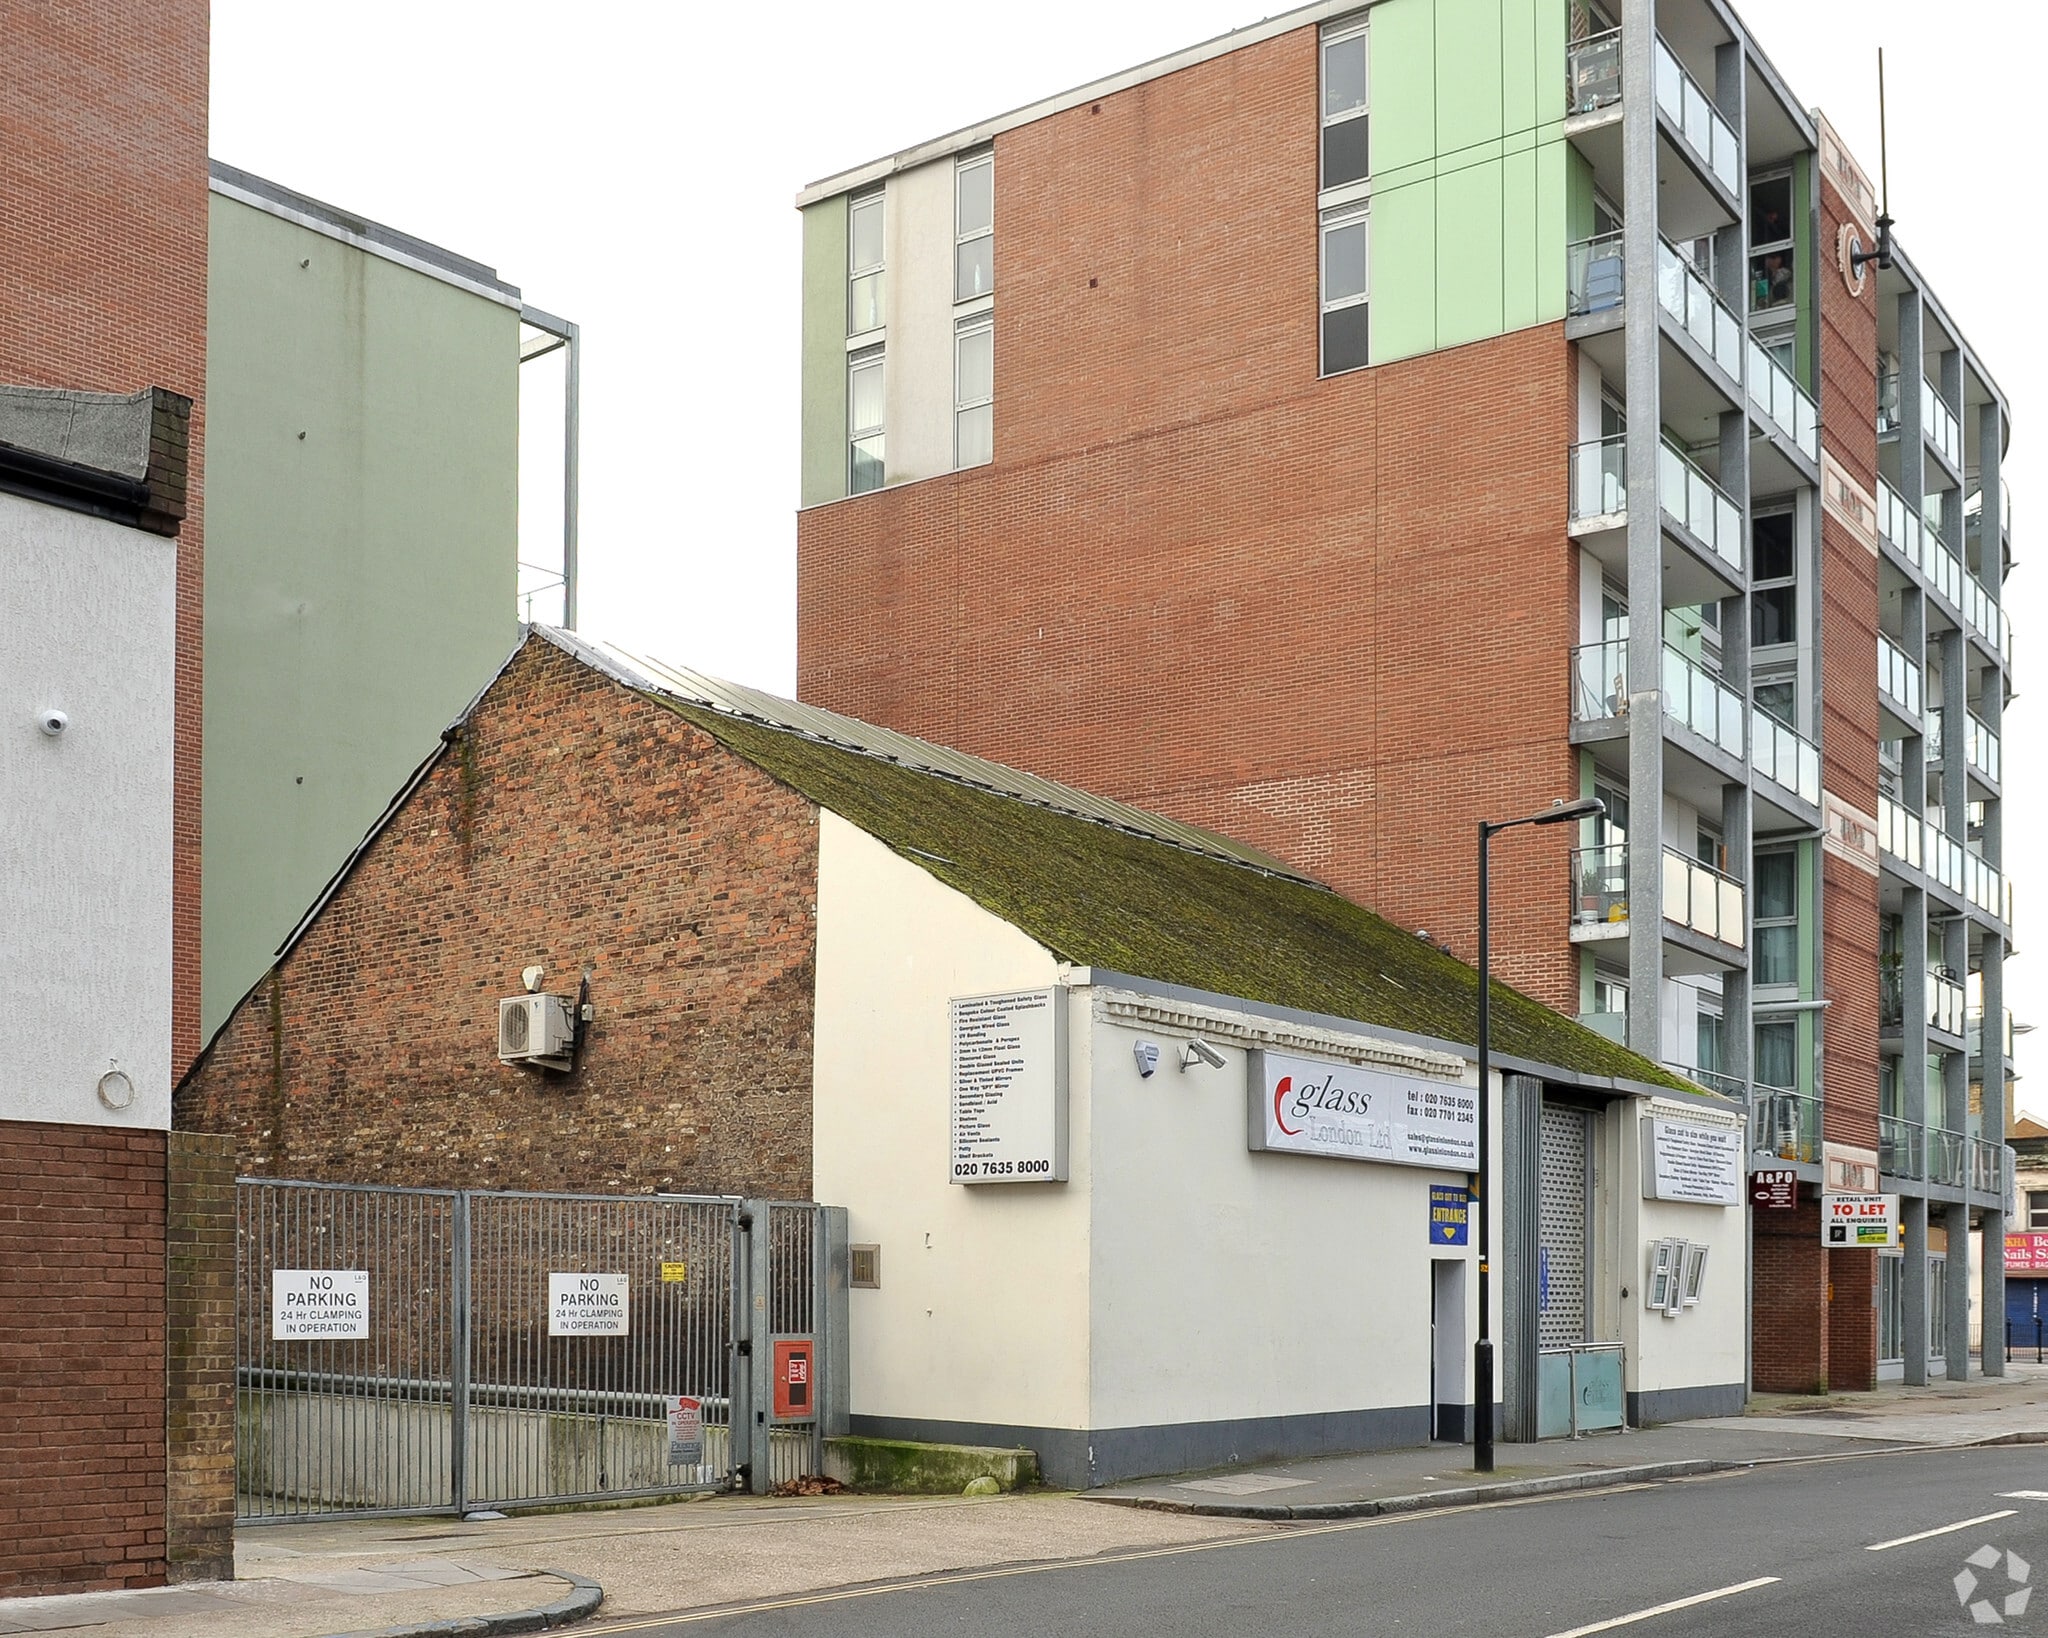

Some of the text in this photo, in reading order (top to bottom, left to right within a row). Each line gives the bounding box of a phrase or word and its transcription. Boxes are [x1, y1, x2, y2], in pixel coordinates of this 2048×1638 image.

[1408, 1090, 1418, 1101] tel
[1425, 1093, 1437, 1104] 020
[1440, 1095, 1455, 1107] 7635
[1457, 1098, 1473, 1109] 8000
[1407, 1104, 1418, 1115] fax
[1424, 1107, 1437, 1118] 020
[1439, 1109, 1454, 1120] 7701
[1457, 1112, 1473, 1123] 2345
[1310, 1116, 1392, 1150] London Ltd
[955, 1160, 1049, 1176] 020 7635 8000
[1433, 1207, 1466, 1224] ENTRANCE
[1832, 1204, 1885, 1215] TO LET
[310, 1276, 333, 1290] NO
[580, 1279, 599, 1291] NO
[287, 1293, 356, 1306] PARKING
[561, 1294, 618, 1305] PARKING
[281, 1310, 362, 1320] 24 Hr CLAMPING
[286, 1323, 356, 1333] IN OPERATION
[571, 1321, 618, 1329] OPERATION
